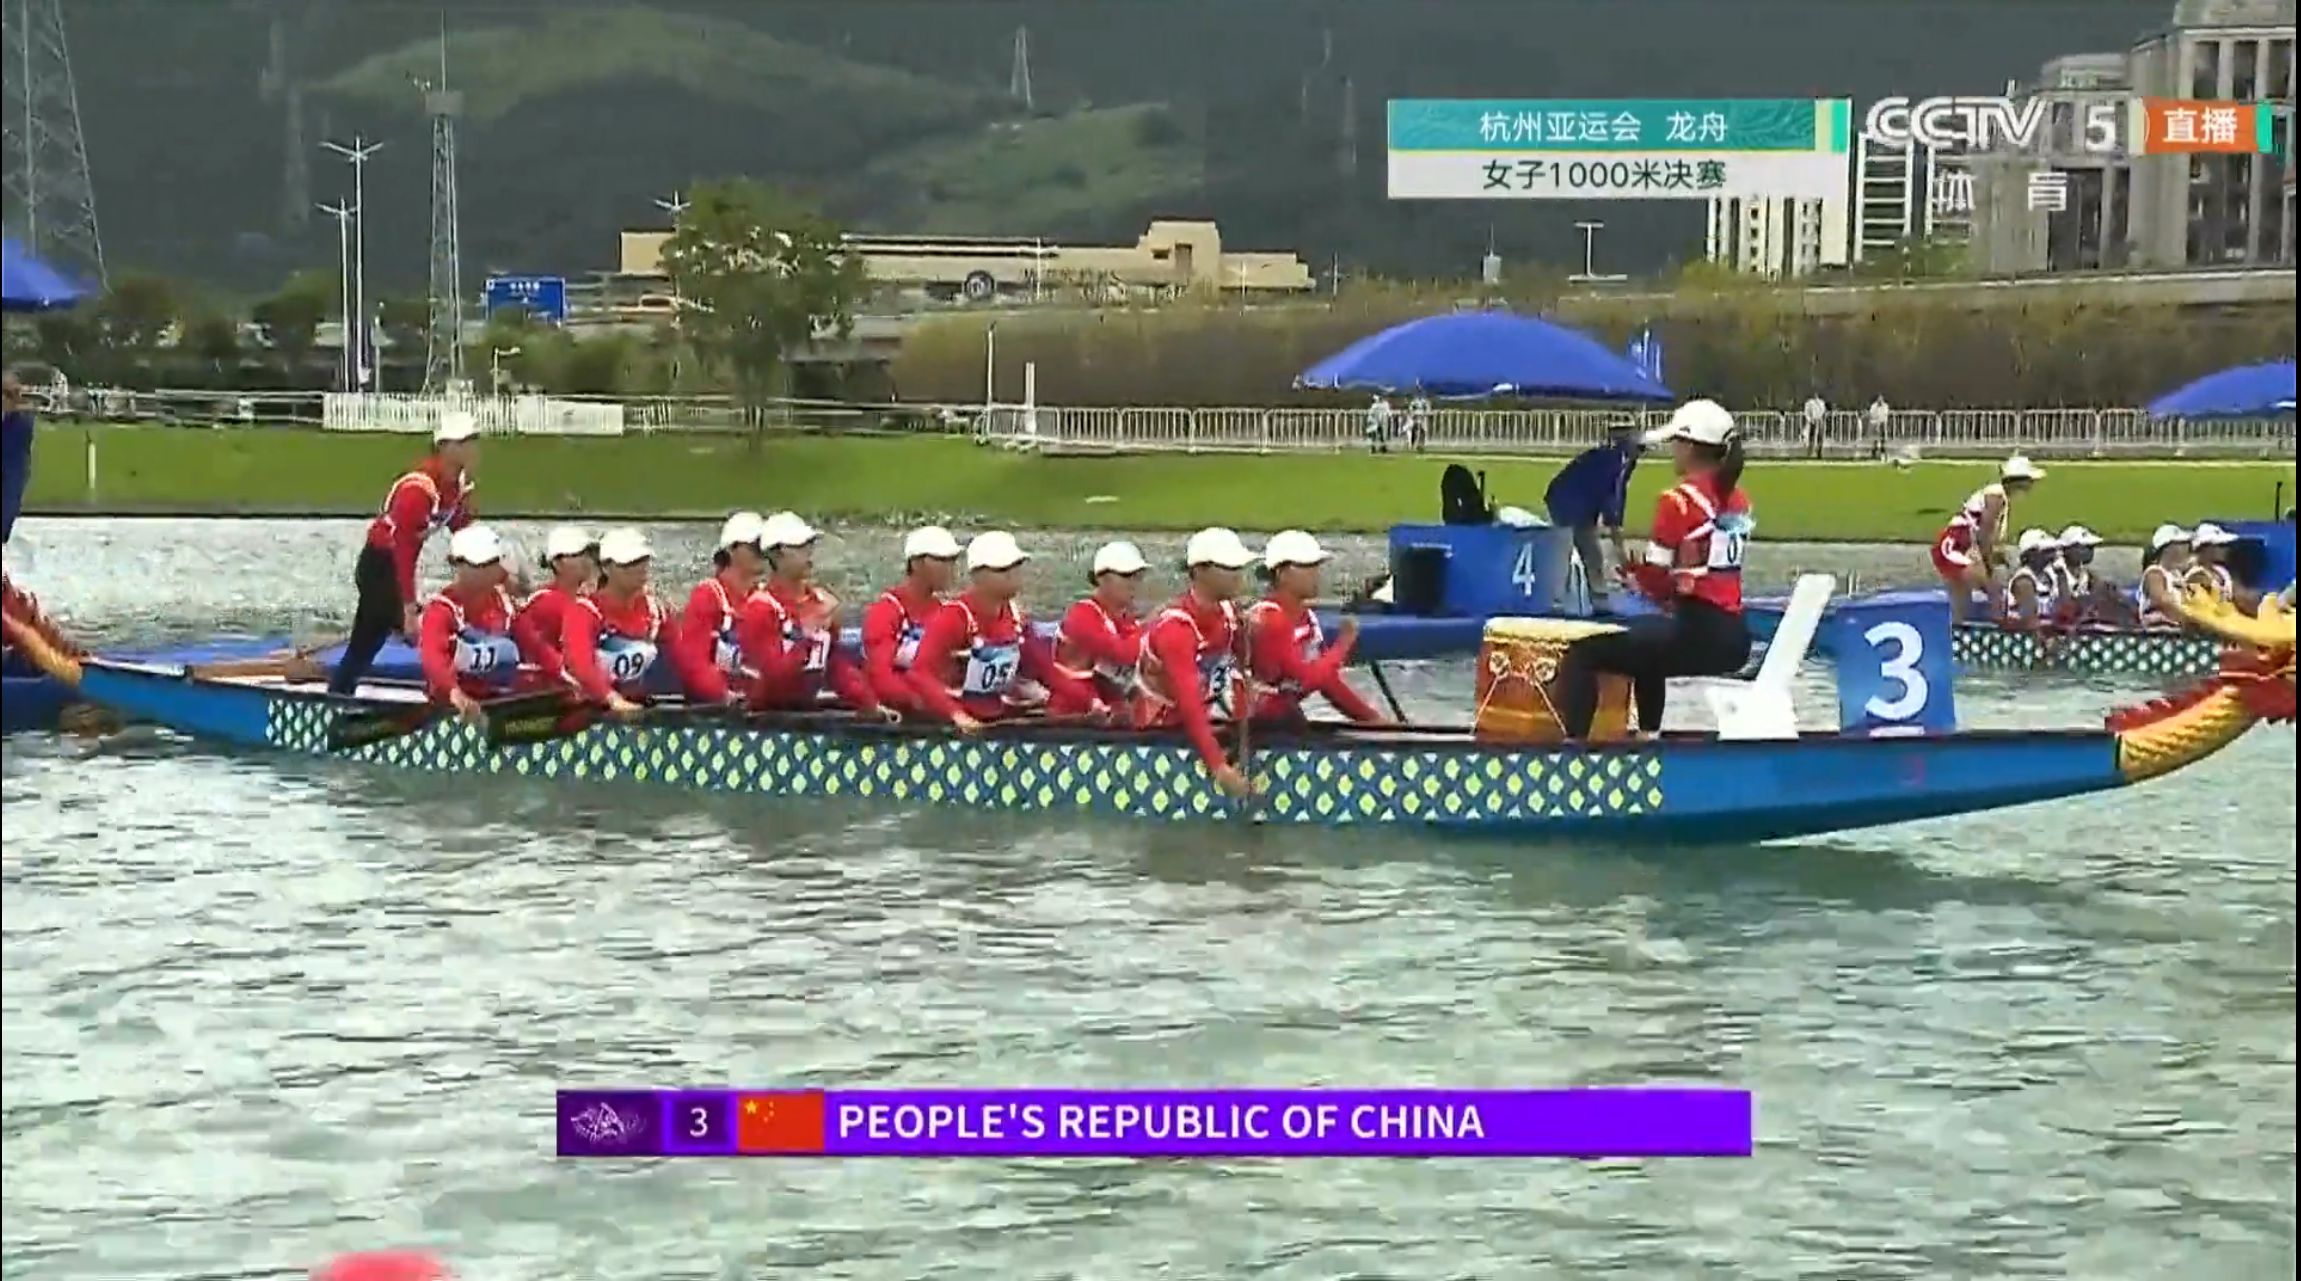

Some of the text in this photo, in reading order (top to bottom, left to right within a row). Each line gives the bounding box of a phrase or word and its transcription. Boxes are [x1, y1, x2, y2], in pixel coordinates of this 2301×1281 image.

[1512, 543, 1536, 596] 4
[615, 653, 644, 677] 09
[1863, 622, 1929, 721] 3
